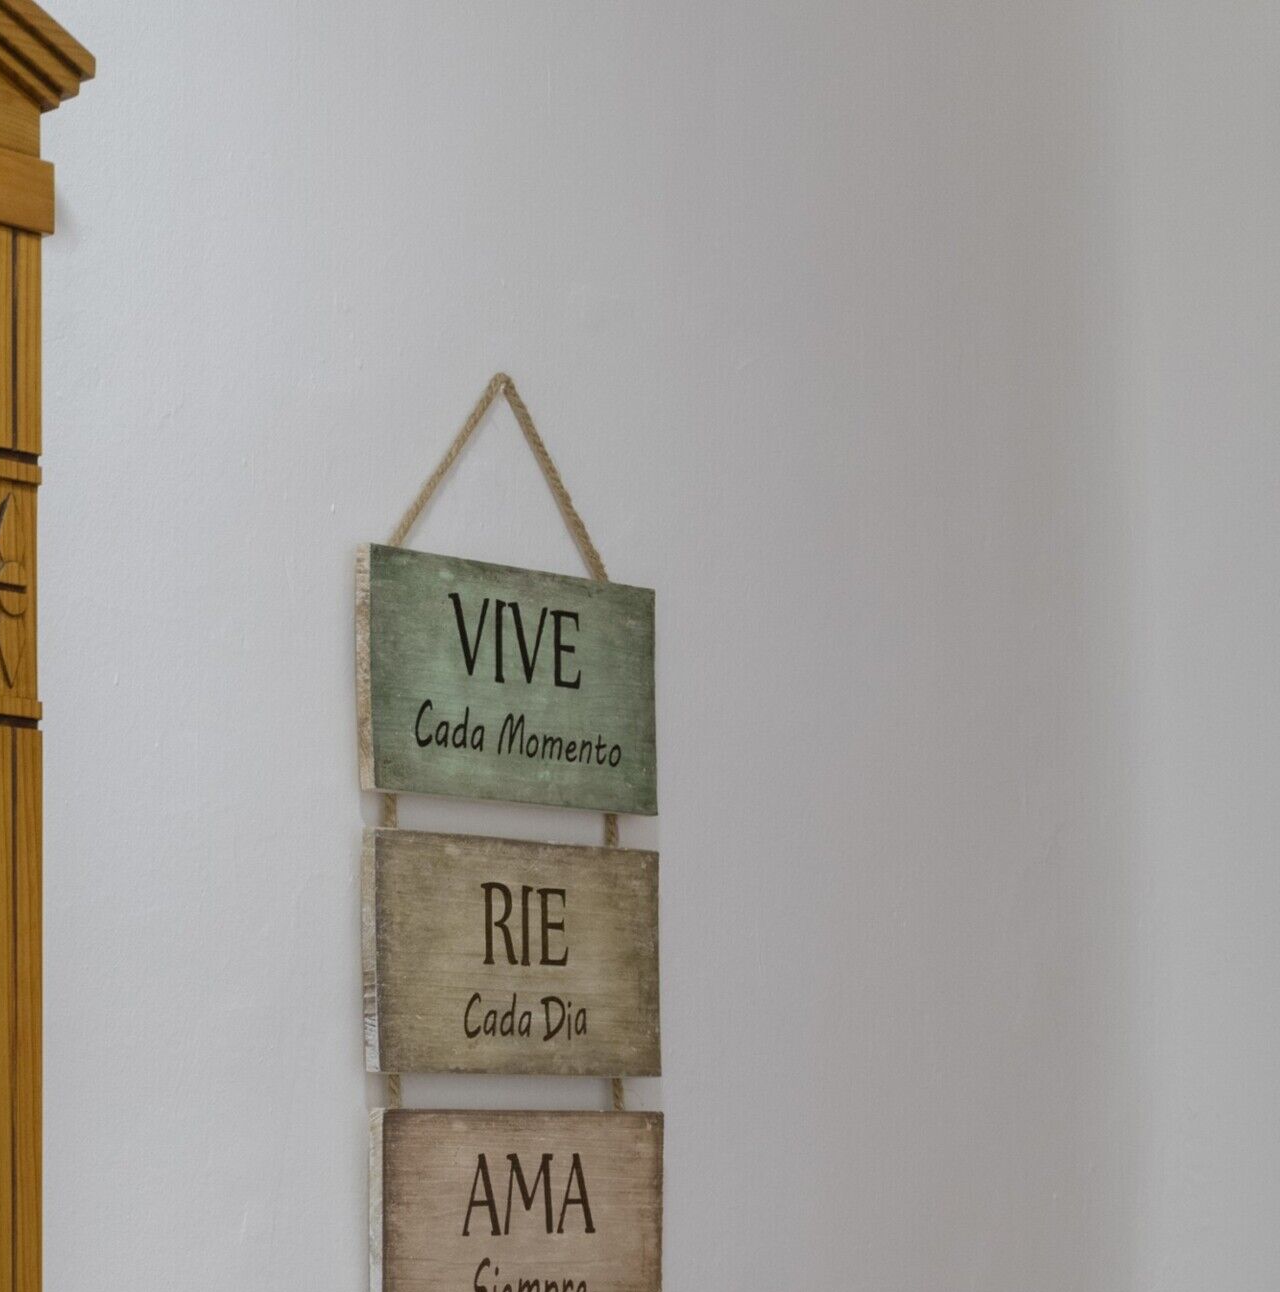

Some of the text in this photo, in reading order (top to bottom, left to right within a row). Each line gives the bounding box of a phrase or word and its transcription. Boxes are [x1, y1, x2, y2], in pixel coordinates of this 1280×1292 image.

[448, 592, 581, 689] VIVE
[414, 699, 622, 767] Cada Momento
[480, 882, 569, 967] RIE
[464, 992, 588, 1041] Cada Dia
[462, 1153, 596, 1237] AMA
